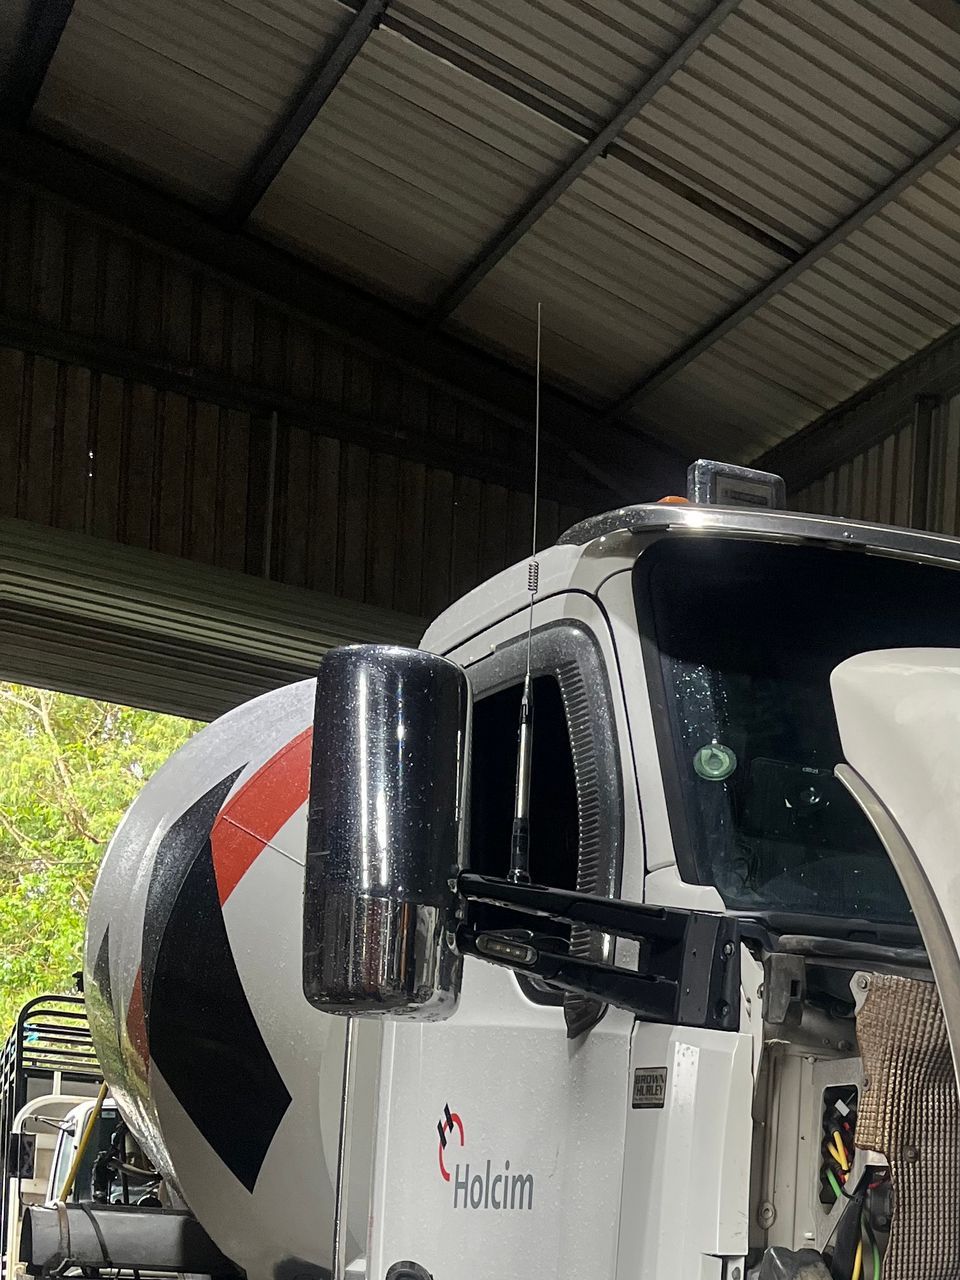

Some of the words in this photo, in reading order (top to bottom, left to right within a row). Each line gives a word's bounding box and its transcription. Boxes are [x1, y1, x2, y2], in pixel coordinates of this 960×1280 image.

[634, 1074, 665, 1085] BROWN
[635, 1085, 664, 1096] HURLEY
[453, 1160, 534, 1210] Holcim
